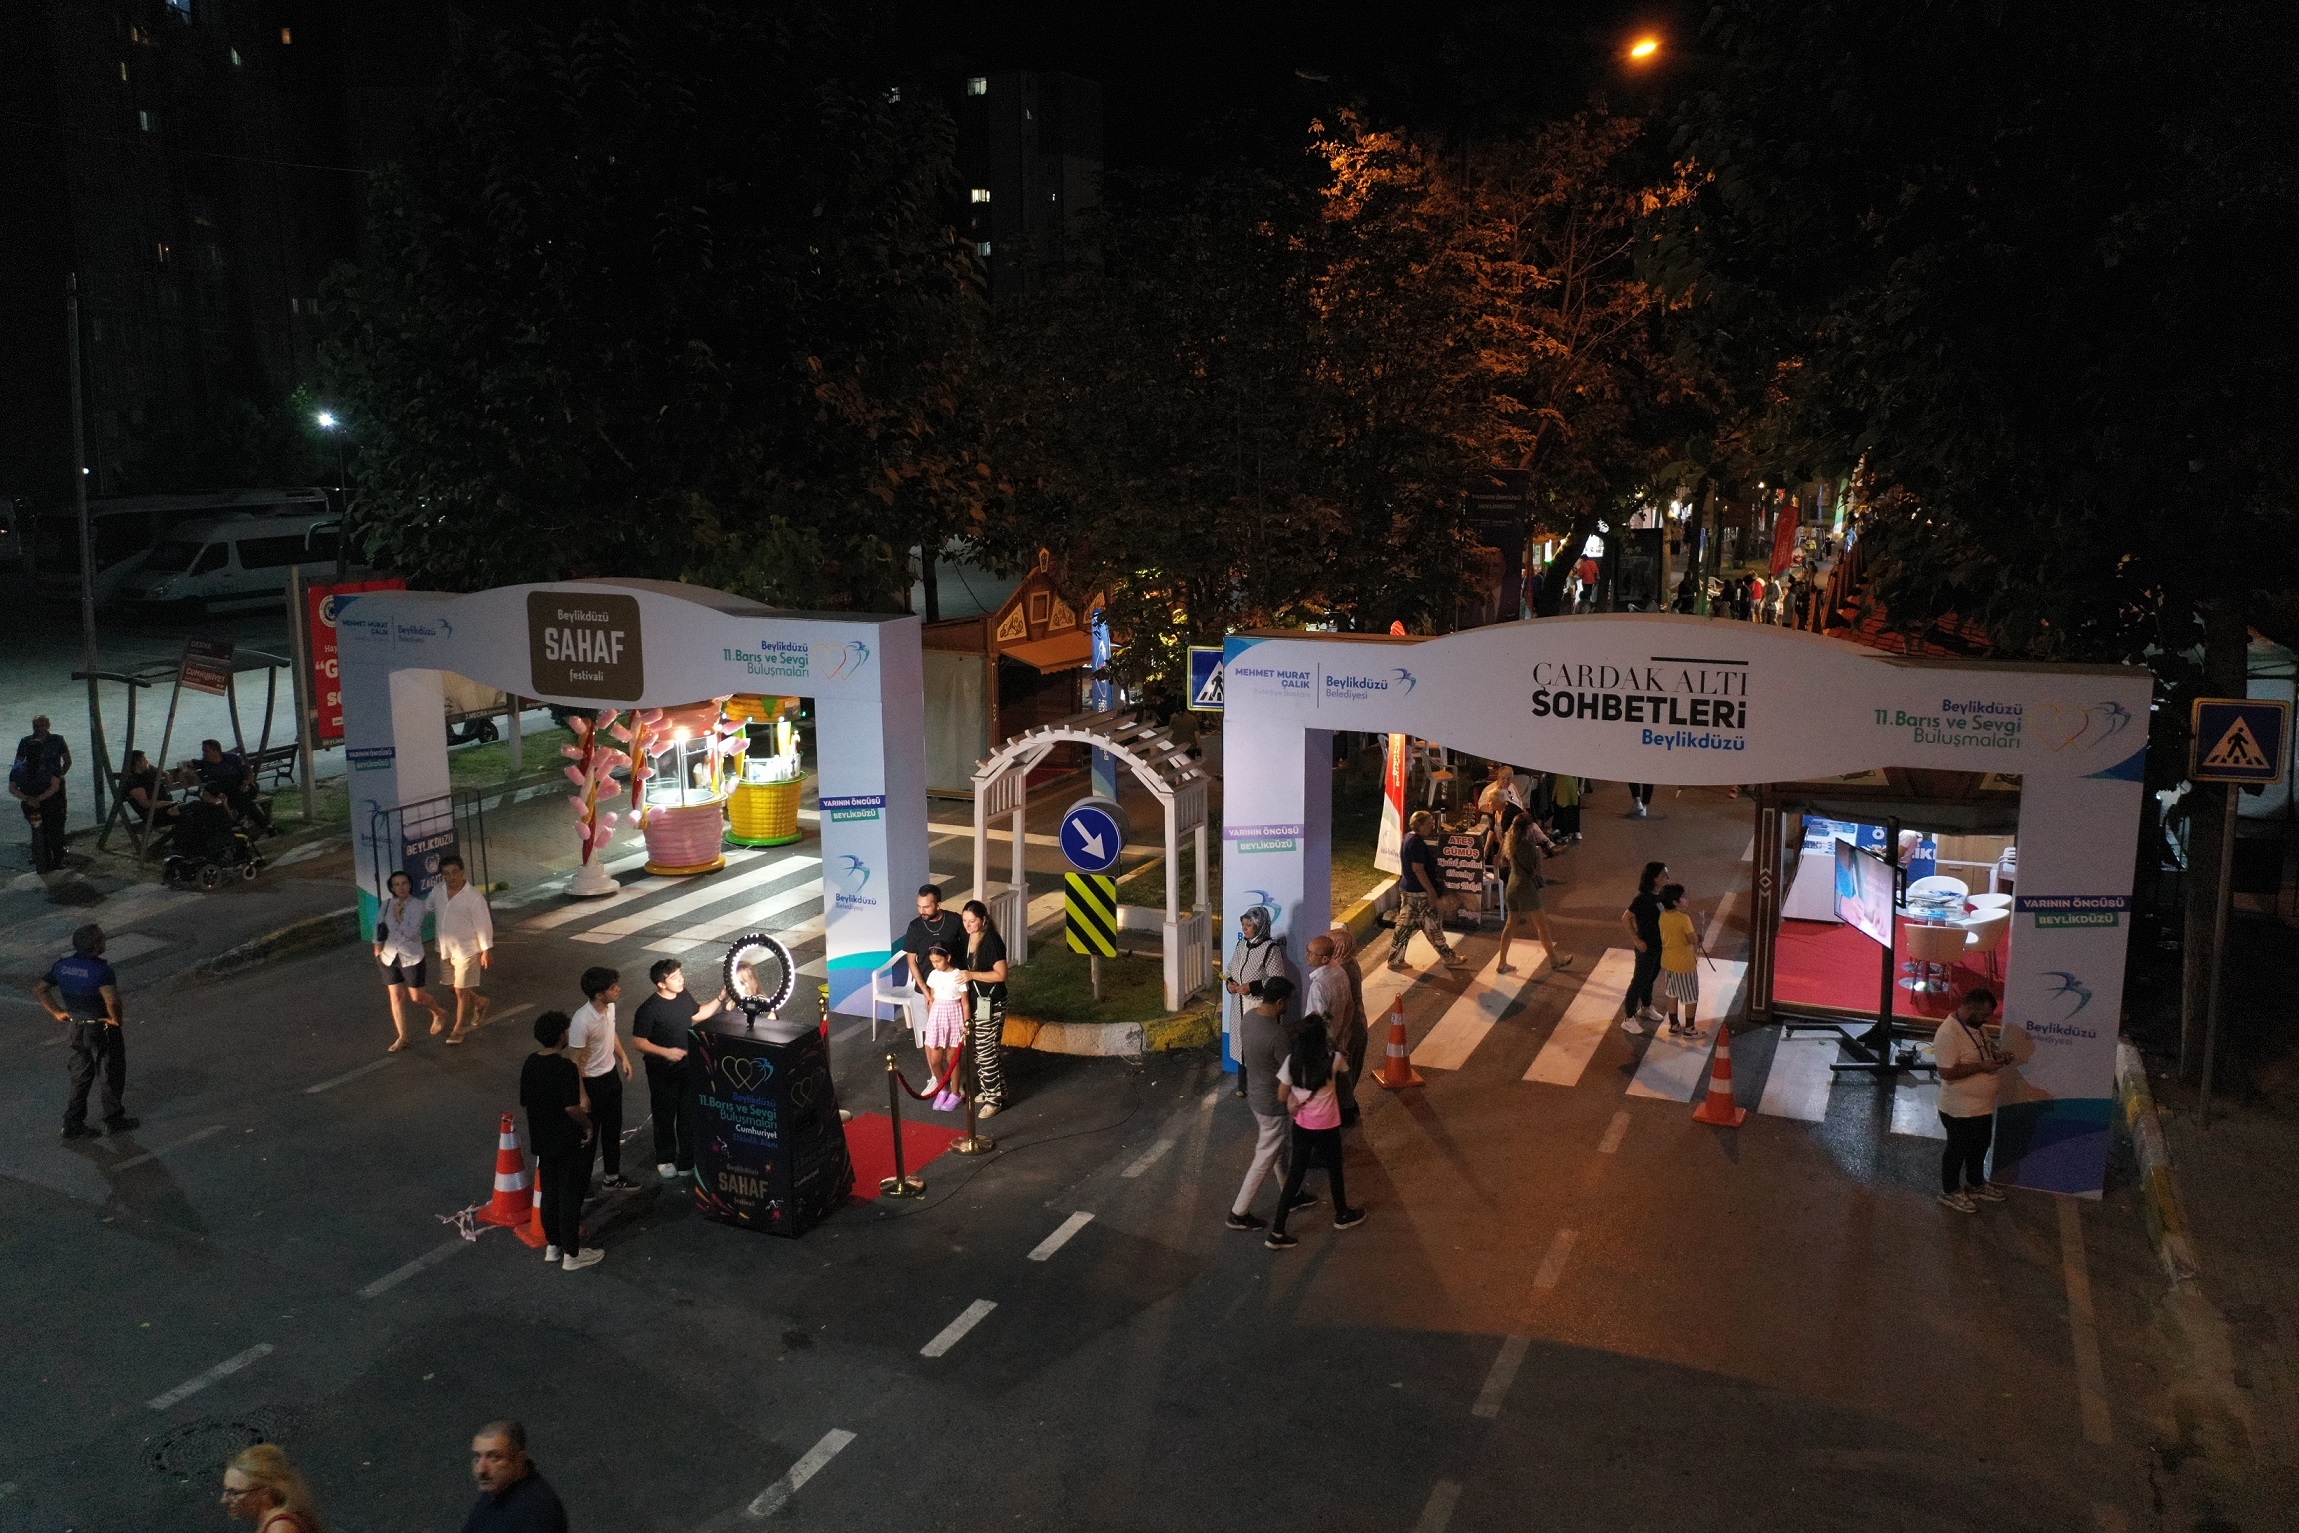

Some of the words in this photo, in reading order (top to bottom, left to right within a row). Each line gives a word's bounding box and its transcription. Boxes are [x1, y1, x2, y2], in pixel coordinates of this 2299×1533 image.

[557, 609, 609, 623] Beylikdüzü
[397, 625, 437, 638] Beylikdüzü
[544, 627, 625, 665] SAHAF
[761, 640, 808, 653] Beylikdüzü
[764, 653, 777, 663] ve
[779, 652, 809, 668] Sevgi
[569, 669, 604, 682] festivali
[747, 661, 809, 678] Buluşmaları
[1235, 667, 1275, 679] MEHMET
[1276, 670, 1310, 680] MURAT
[1280, 679, 1310, 690] ÇALIK
[1326, 675, 1388, 691] Beylikdüzü
[1532, 662, 1665, 692] ÇARDAK
[1674, 669, 1750, 696] ALTI
[1326, 688, 1368, 701] Belediyesi
[1942, 699, 2023, 716] Beylikdüzü
[1946, 717, 1967, 730] ve
[1971, 714, 2021, 737] Sevgi
[1641, 729, 1745, 751] Beylikdüzü
[822, 799, 851, 808] YARININ
[851, 797, 881, 807] ÖNCÜSÜ
[832, 809, 876, 820] BEYLİKDÜZÜ
[1228, 828, 1262, 837] YARININ
[1262, 826, 1299, 837] ÖNCÜSÜ
[1240, 840, 1293, 851] BEYLİKDÜZÜ
[1449, 836, 1475, 847] ATEŞ
[1442, 846, 1480, 860] GÜMÜŞ
[836, 893, 877, 906] Beylikdüzü
[2023, 899, 2071, 908] YARININ
[2072, 897, 2125, 908] ÖNCÜSÜ
[836, 902, 863, 911] Belediyesi
[2038, 913, 2113, 925] BEYLİKDÜZÜ
[2026, 1020, 2096, 1039] Beylikdüzü
[2025, 1032, 2073, 1046] Belediyesi
[736, 1105, 748, 1115] ve
[750, 1104, 777, 1121] Sevgi
[735, 1123, 778, 1140] Cumhuriyet
[718, 1171, 768, 1198] SAHAF
